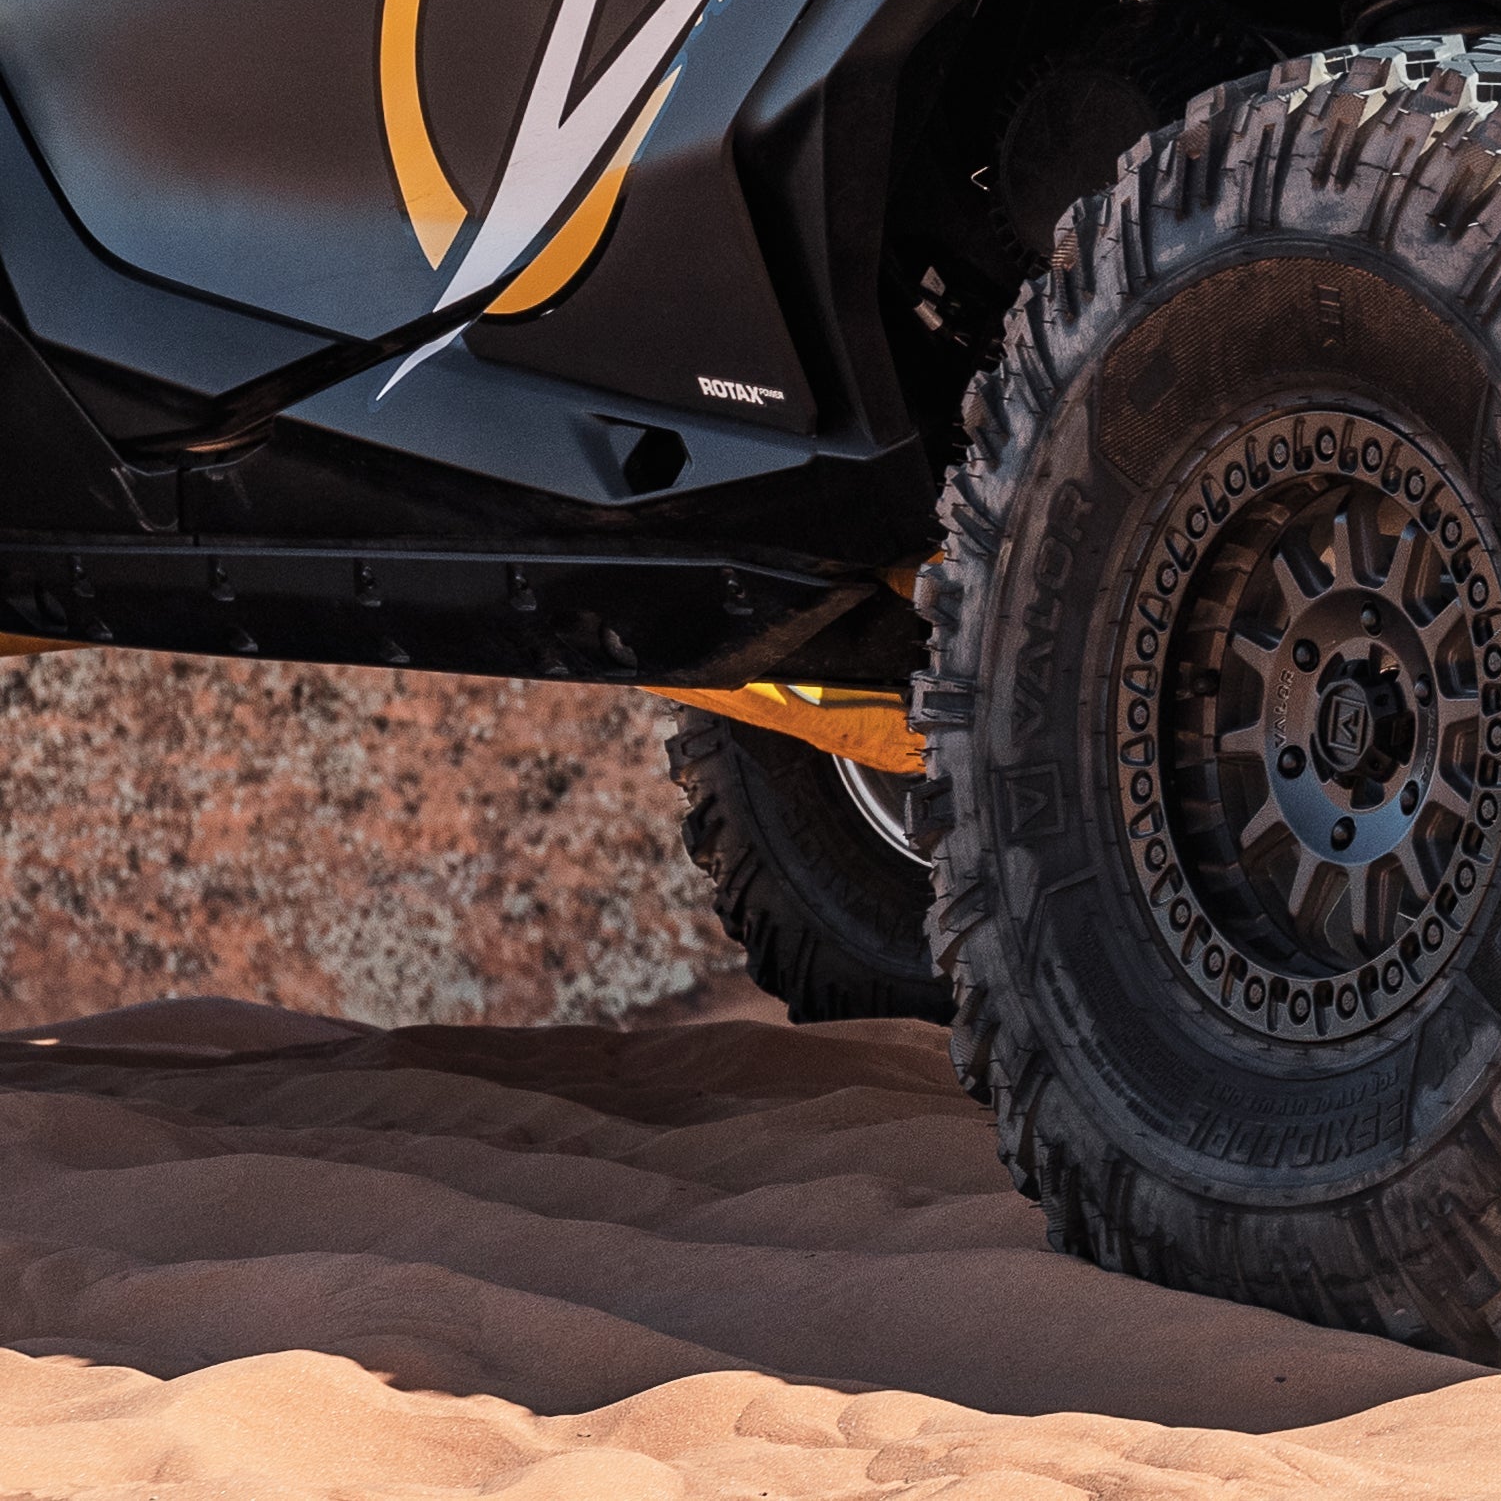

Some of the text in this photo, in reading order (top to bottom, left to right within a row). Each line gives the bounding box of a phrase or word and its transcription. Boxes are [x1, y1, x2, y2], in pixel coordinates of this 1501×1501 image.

[698, 376, 785, 405] ROTAX POWER
[1272, 669, 1296, 749] VALOR
